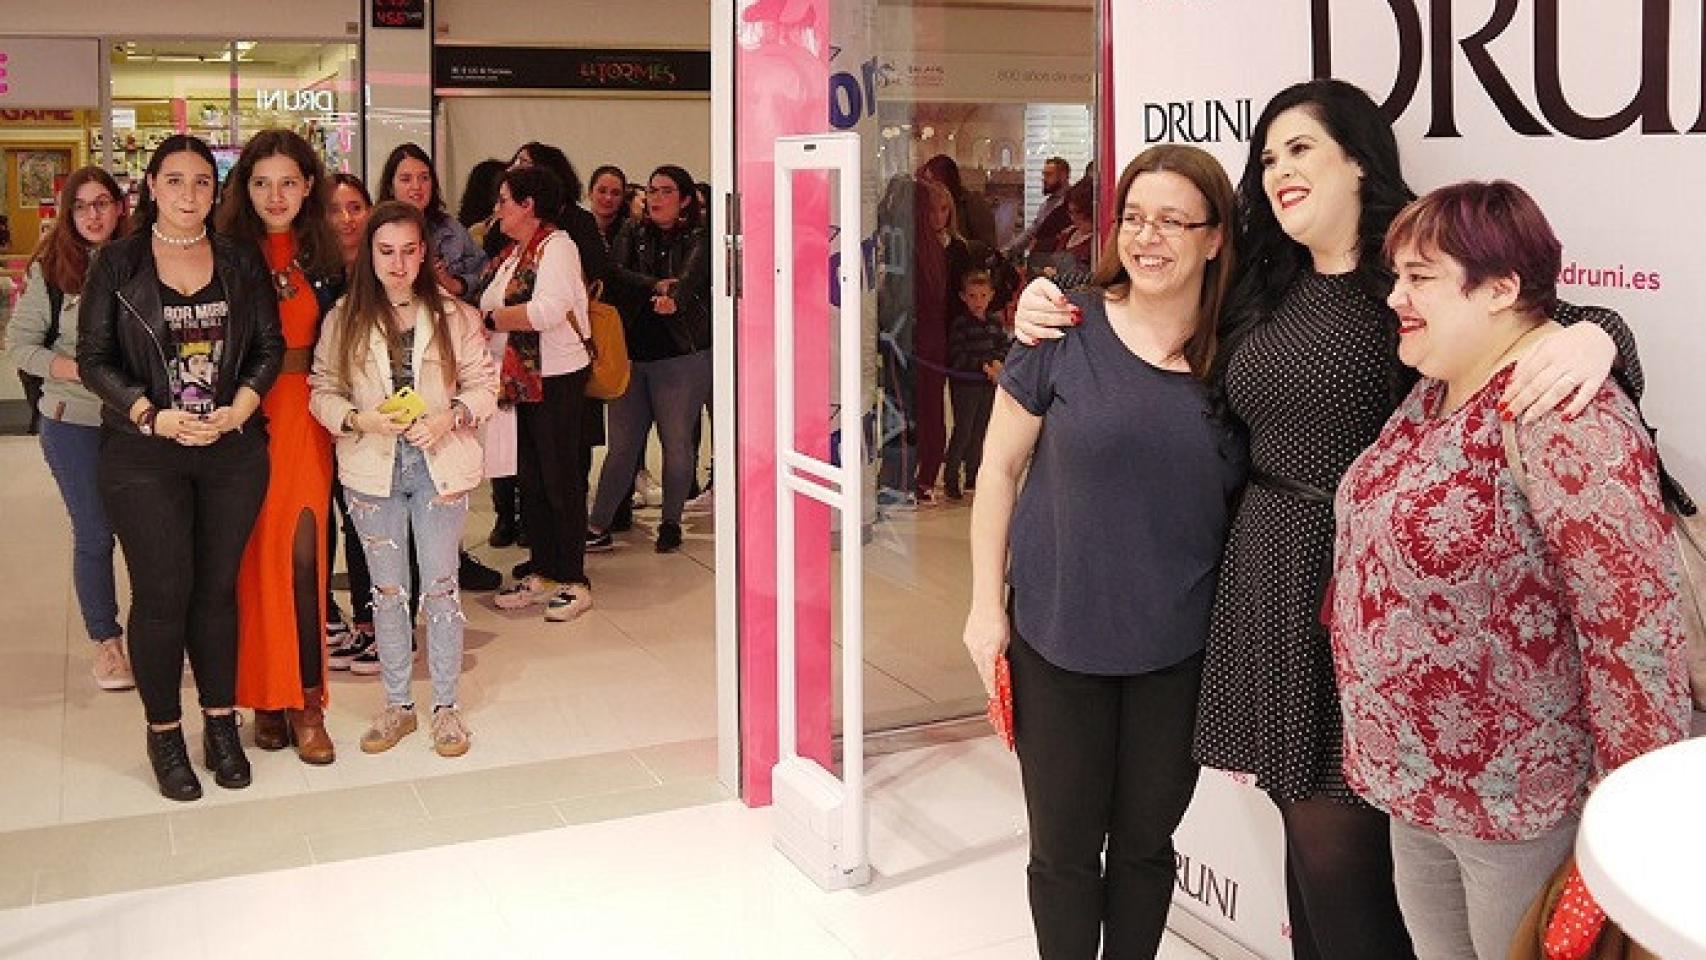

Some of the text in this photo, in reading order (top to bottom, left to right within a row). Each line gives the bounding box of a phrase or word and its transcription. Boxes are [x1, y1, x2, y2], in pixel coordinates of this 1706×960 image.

[1308, 0, 1706, 140] DRU
[0, 108, 74, 121] GAME
[1144, 98, 1253, 143] DRUNI
